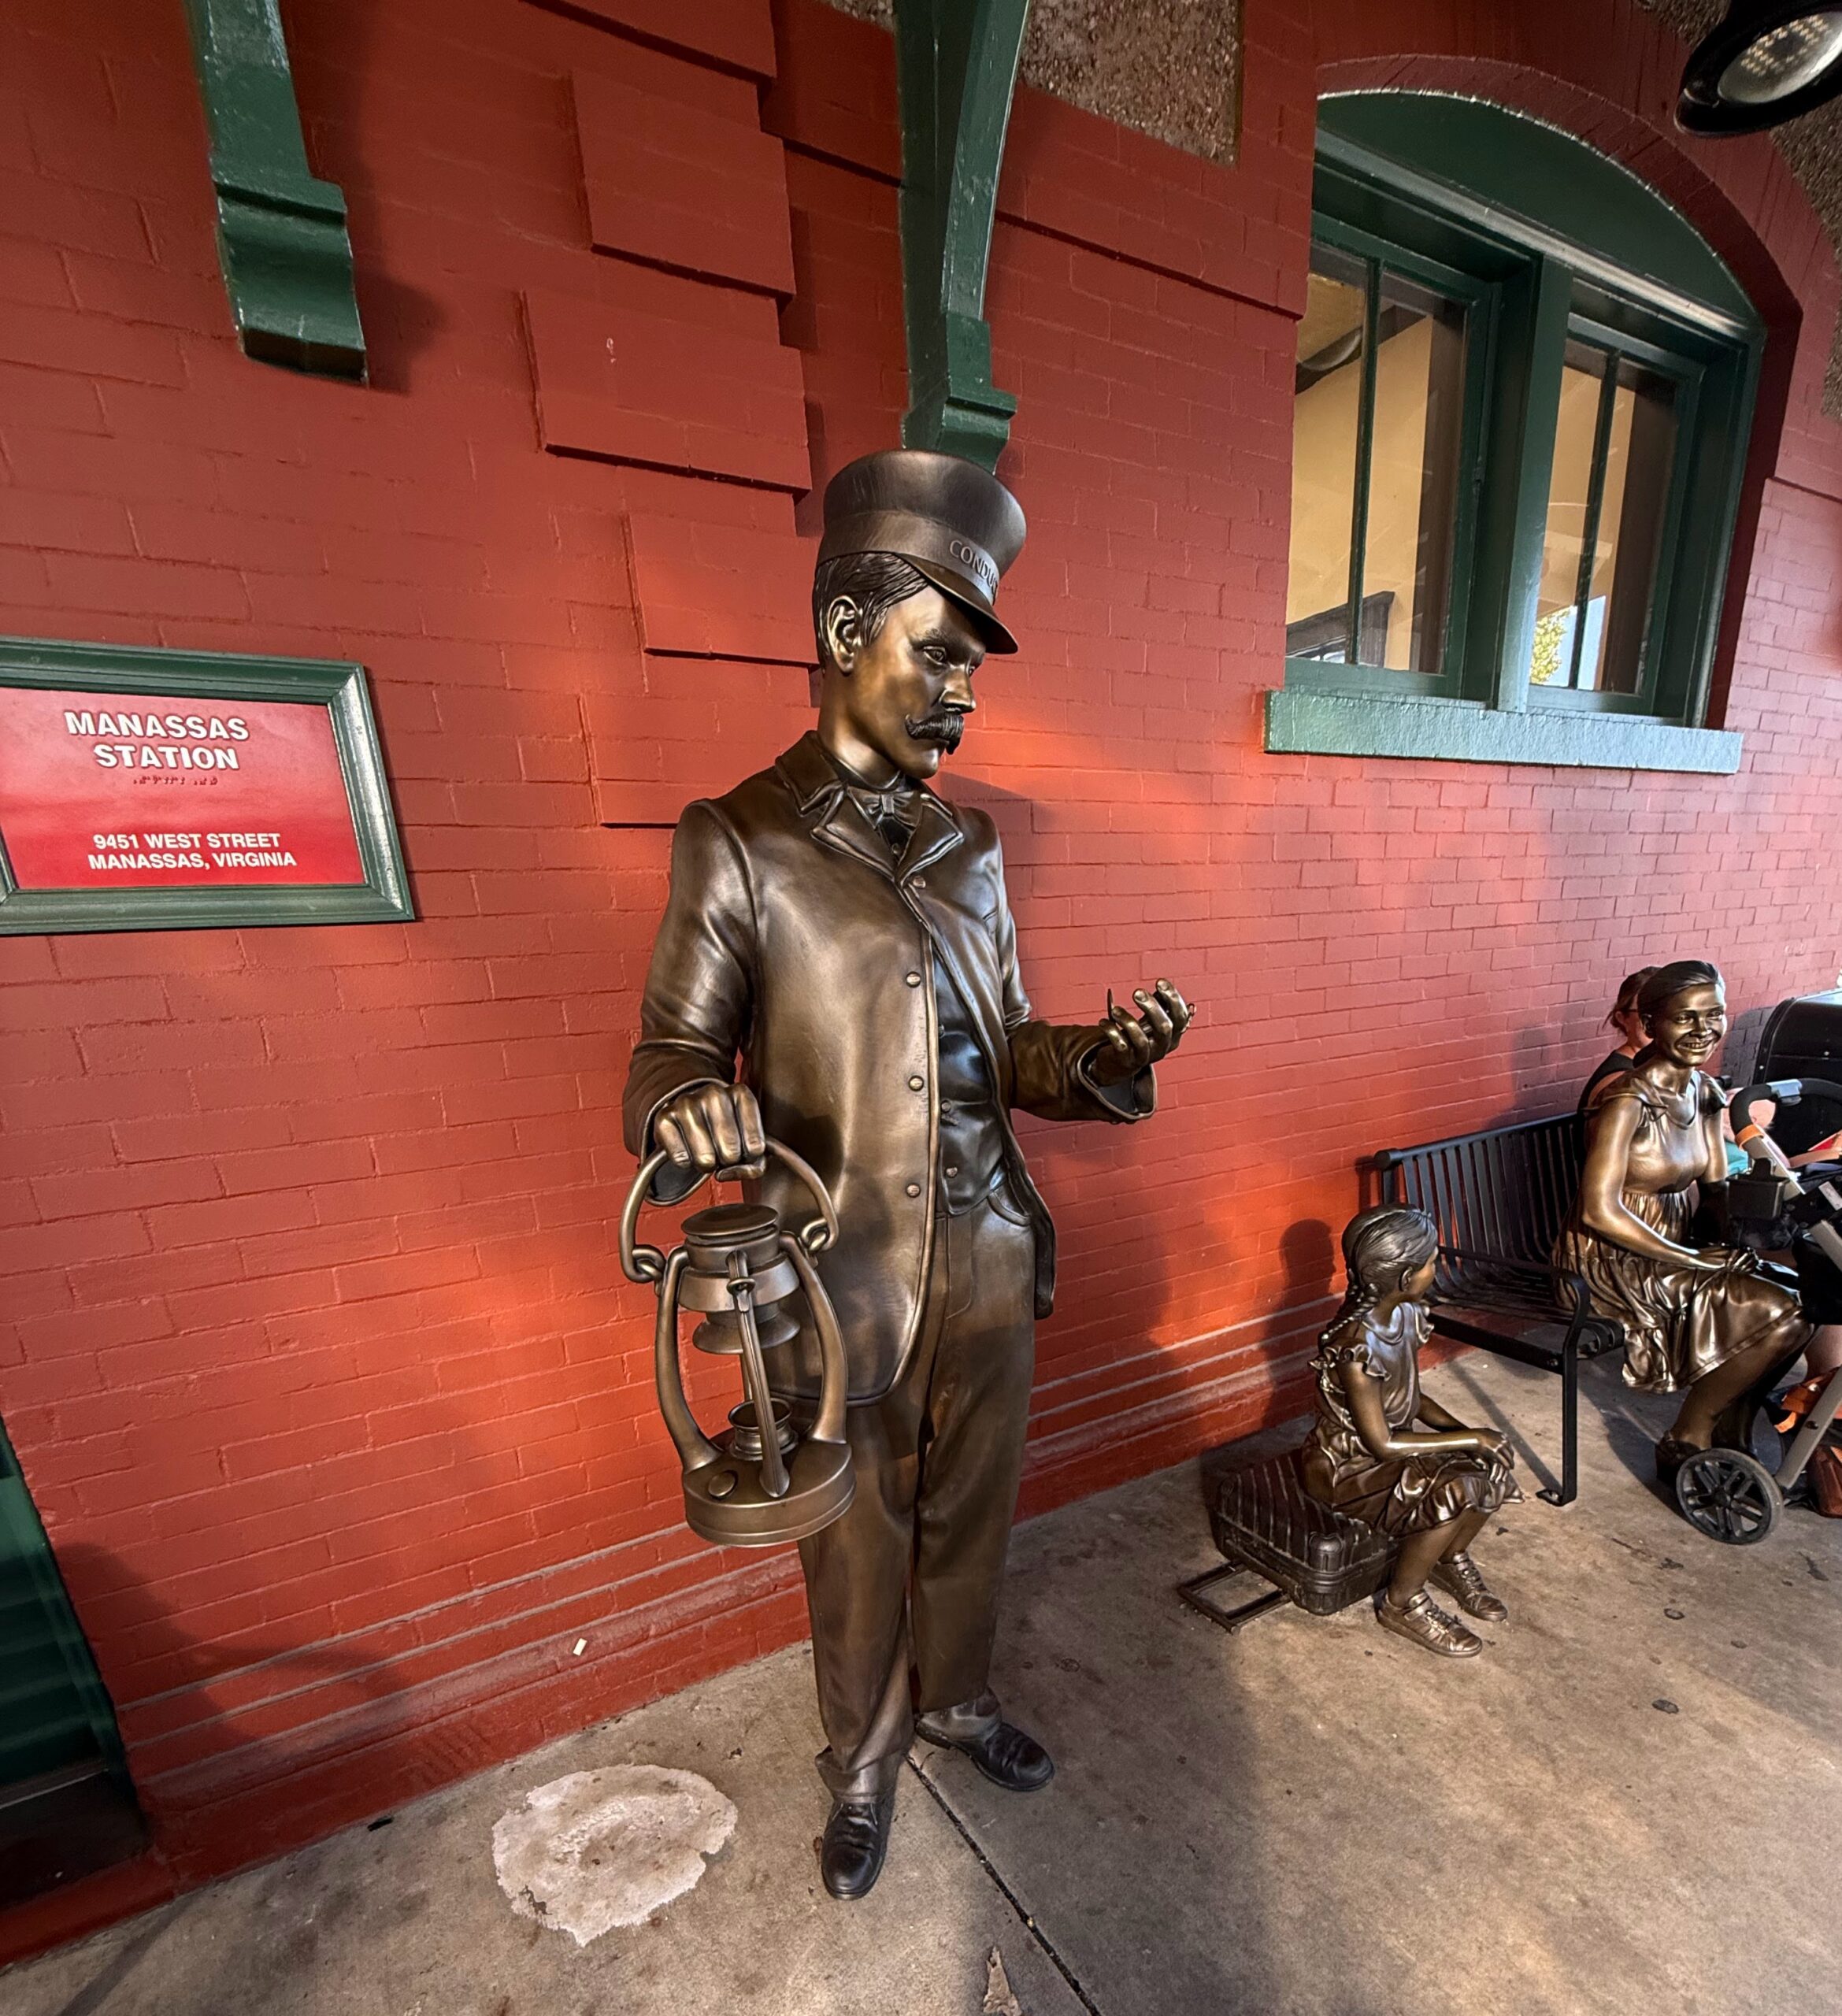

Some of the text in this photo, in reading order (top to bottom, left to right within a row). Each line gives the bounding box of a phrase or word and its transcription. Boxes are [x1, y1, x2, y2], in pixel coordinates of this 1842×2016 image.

[64, 711, 249, 740] MANASSAS
[93, 744, 239, 769] STATION
[93, 832, 280, 850] 9451 WEST STREET
[87, 852, 297, 870] MANASSAS, VIRGINIA
